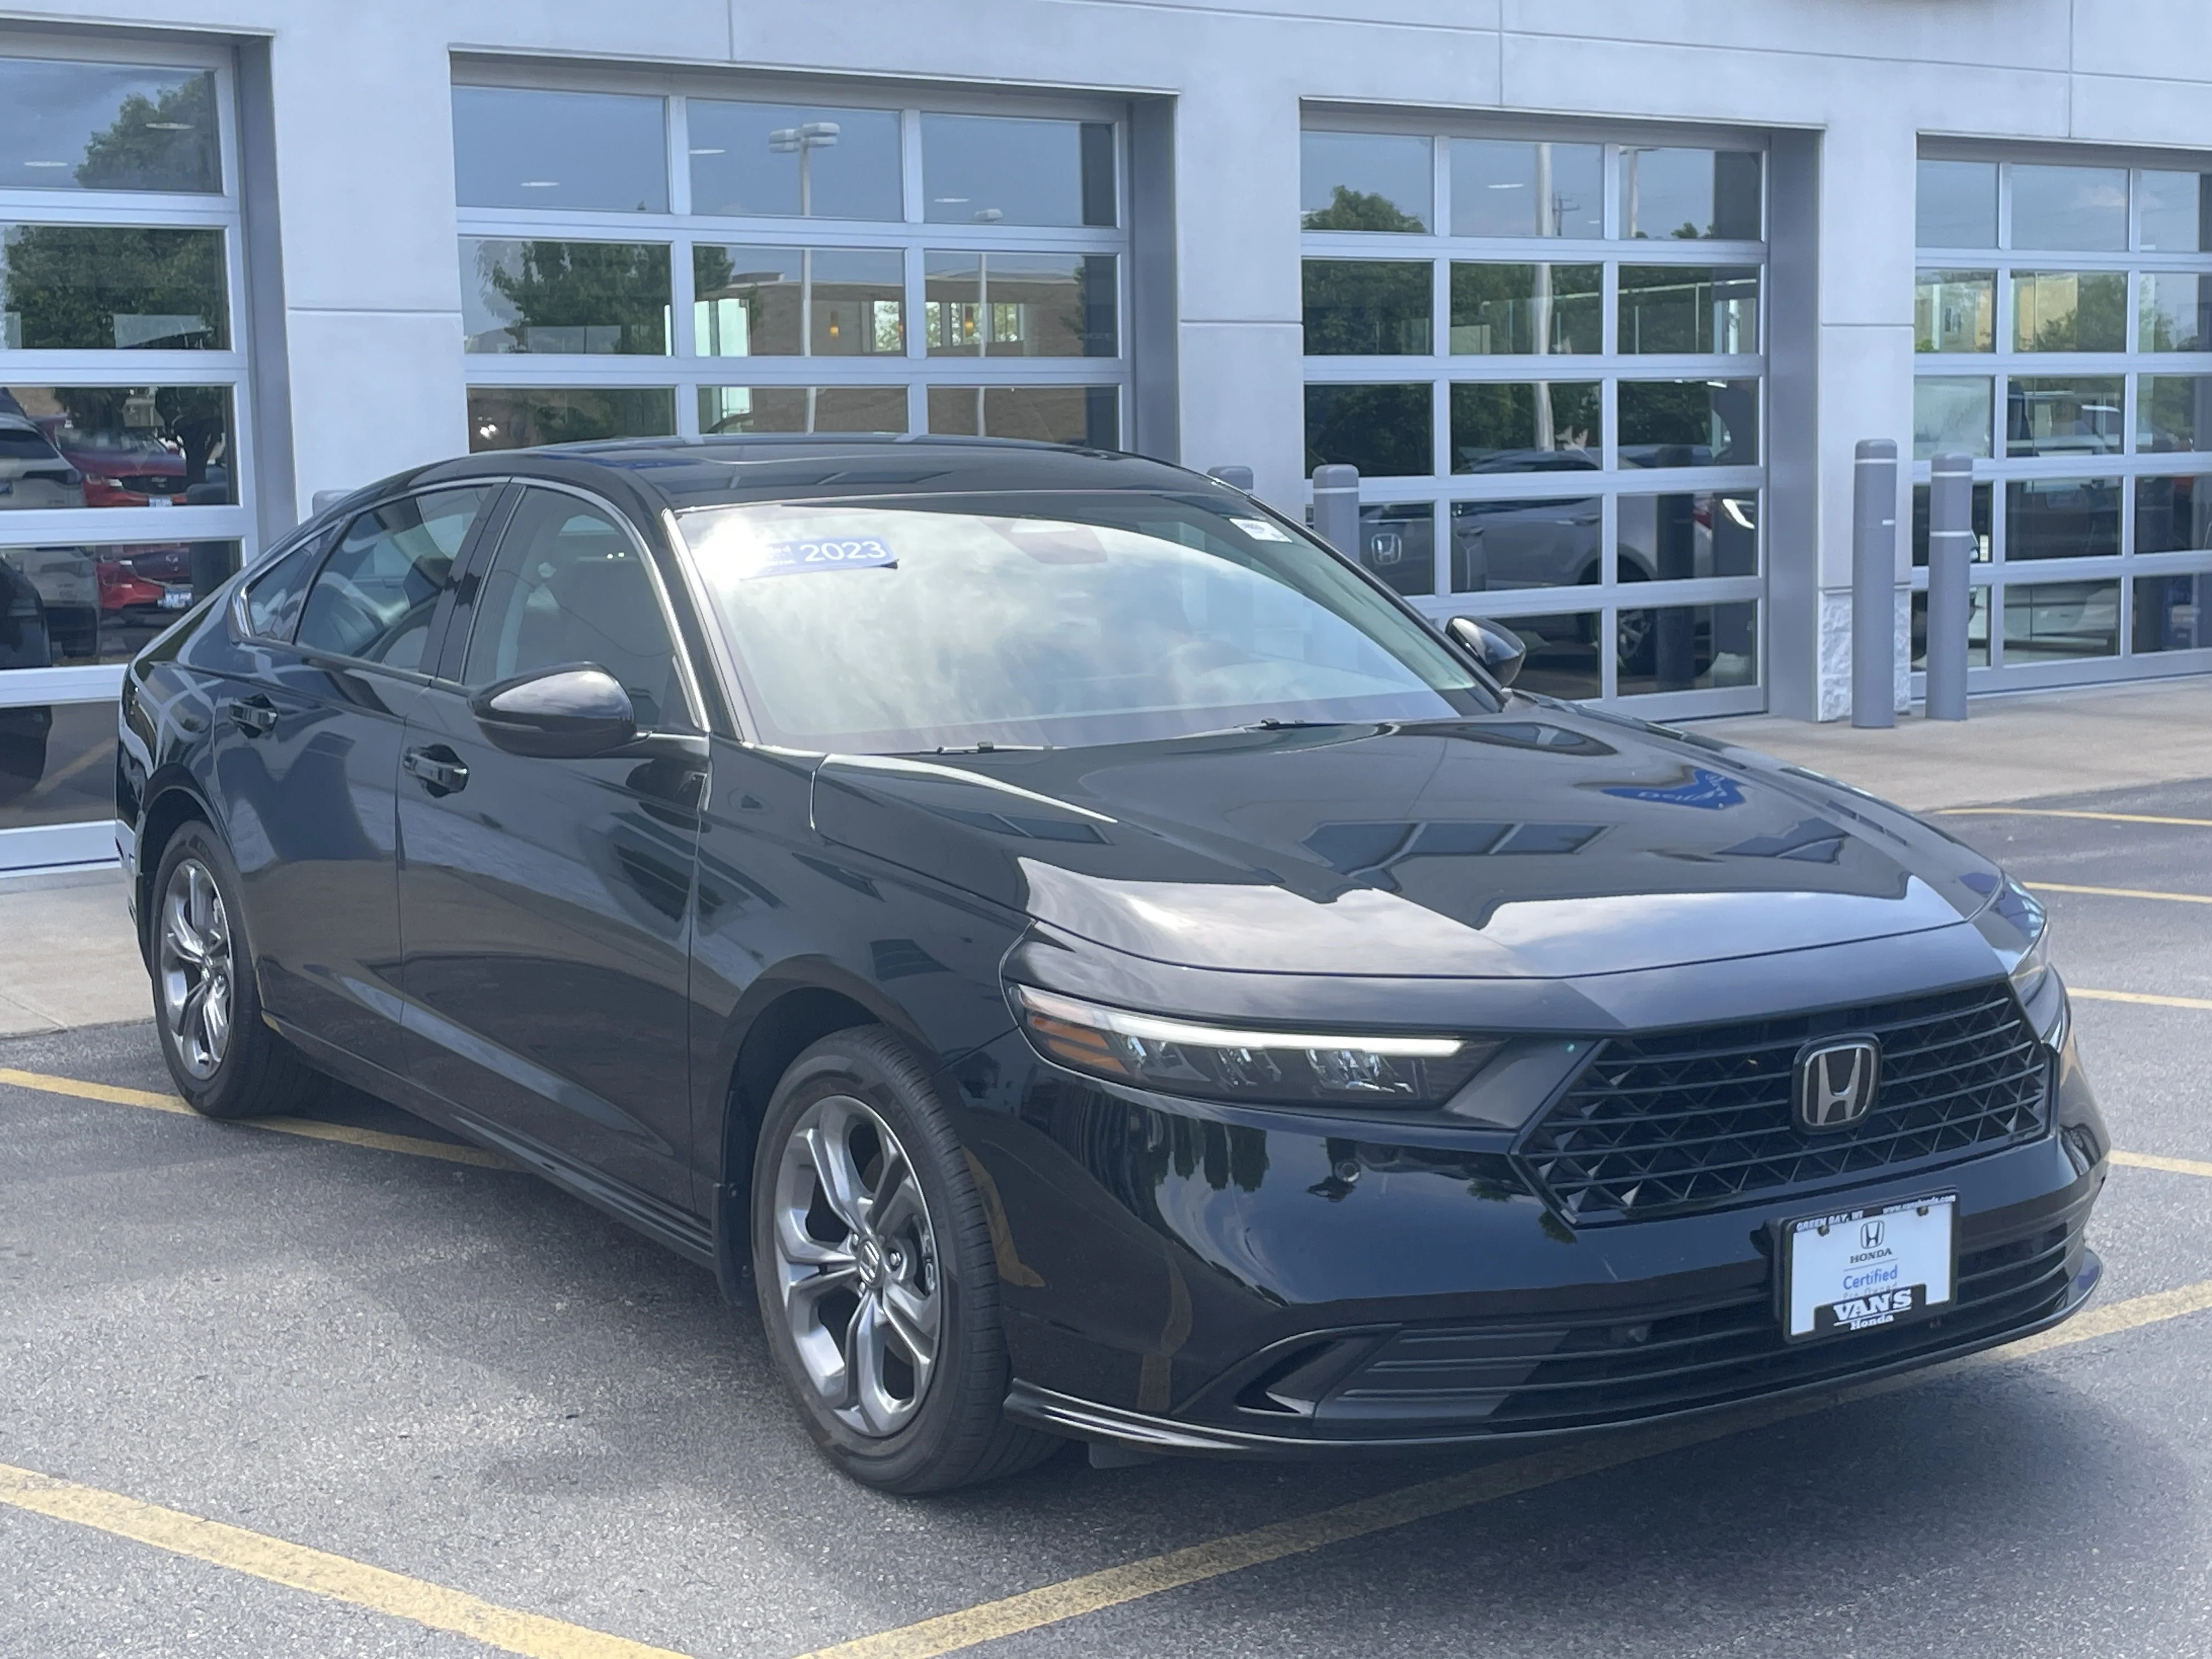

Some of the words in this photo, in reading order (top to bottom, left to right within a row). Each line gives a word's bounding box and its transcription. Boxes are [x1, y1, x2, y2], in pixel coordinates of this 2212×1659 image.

[799, 540, 886, 562] 2023
[1796, 1217, 1827, 1232] GREEN
[1849, 1248, 1893, 1263] HONDA
[1843, 1263, 1898, 1290] Certified
[1850, 1314, 1894, 1330] Honda
